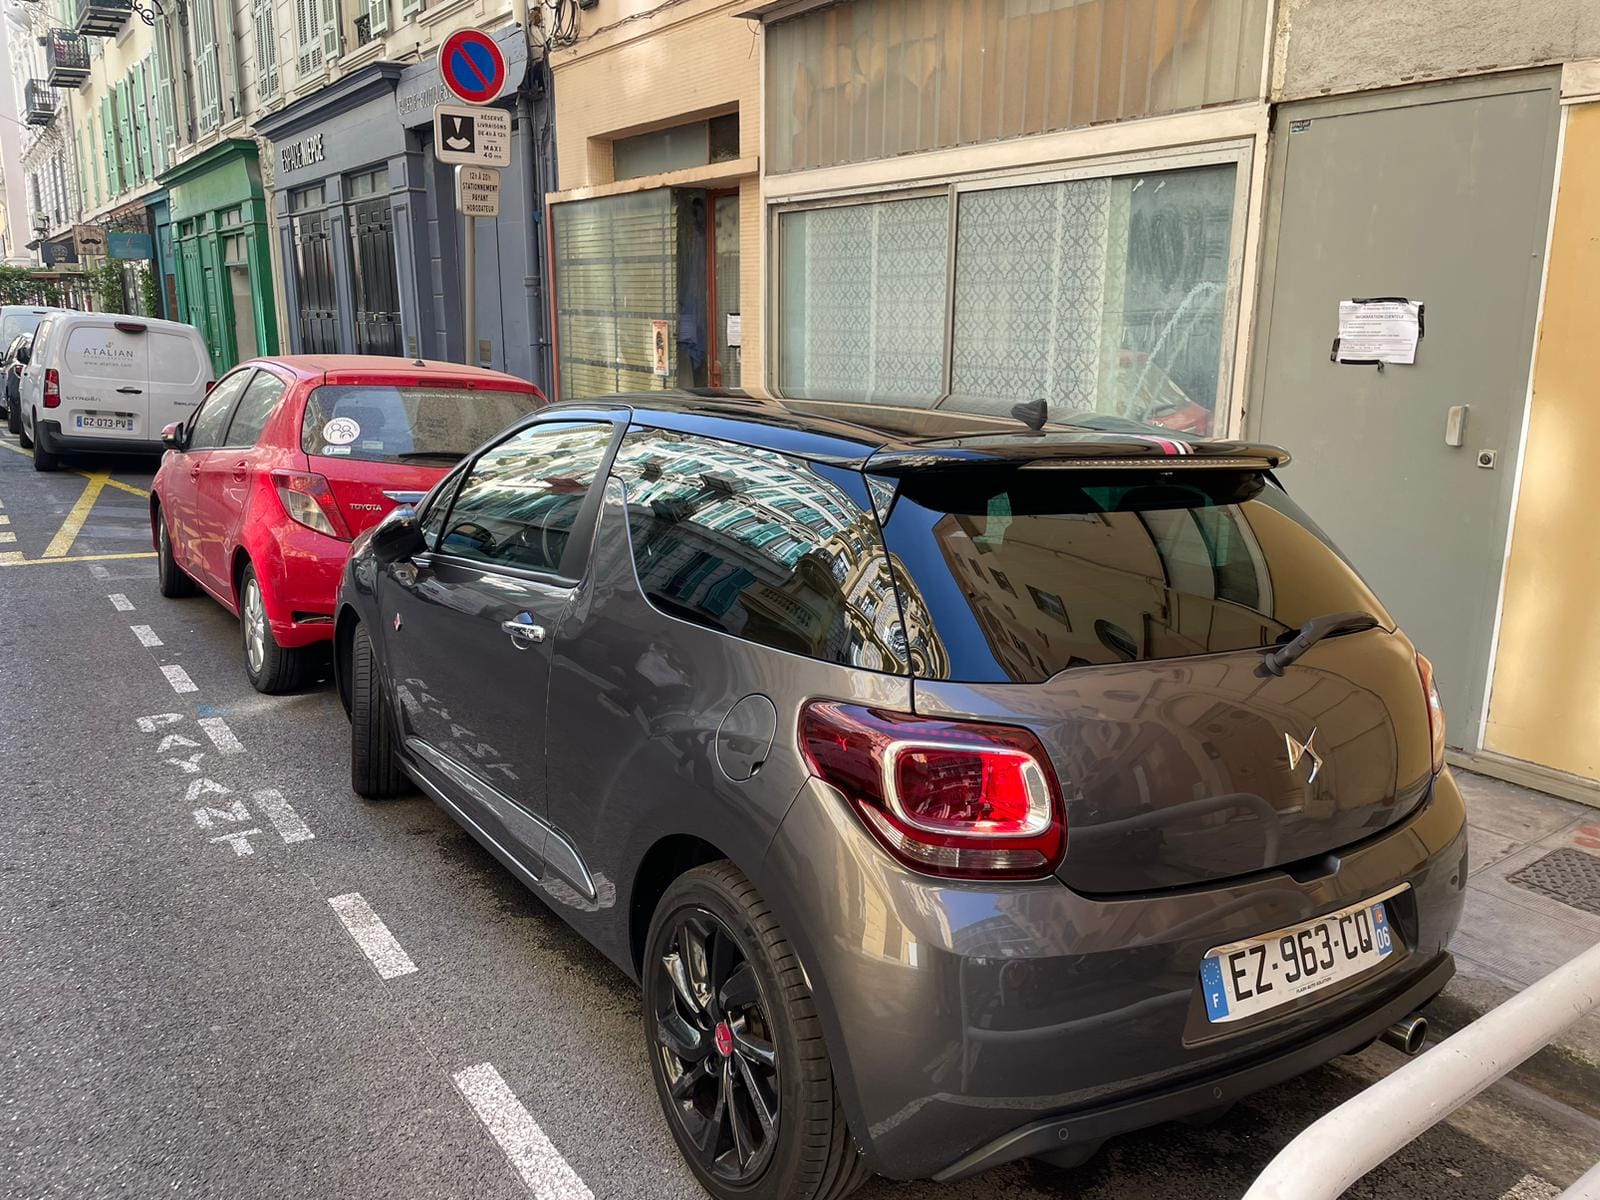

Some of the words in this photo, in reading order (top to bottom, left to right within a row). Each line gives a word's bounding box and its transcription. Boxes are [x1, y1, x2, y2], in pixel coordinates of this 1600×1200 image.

[477, 122, 506, 130] LIVRAISONS
[462, 182, 498, 192] STATIONNEMENT
[472, 193, 489, 201] PAYANT
[466, 204, 494, 213] HORODATEUR
[83, 347, 133, 358] ATALIAN
[83, 417, 127, 429] GZ-073-PV
[349, 503, 382, 511] TOYOTA
[136, 712, 263, 857] PAYANT
[1376, 926, 1391, 949] 06
[1228, 909, 1373, 1002] EZ-963-CQ
[1212, 993, 1220, 1009] F
